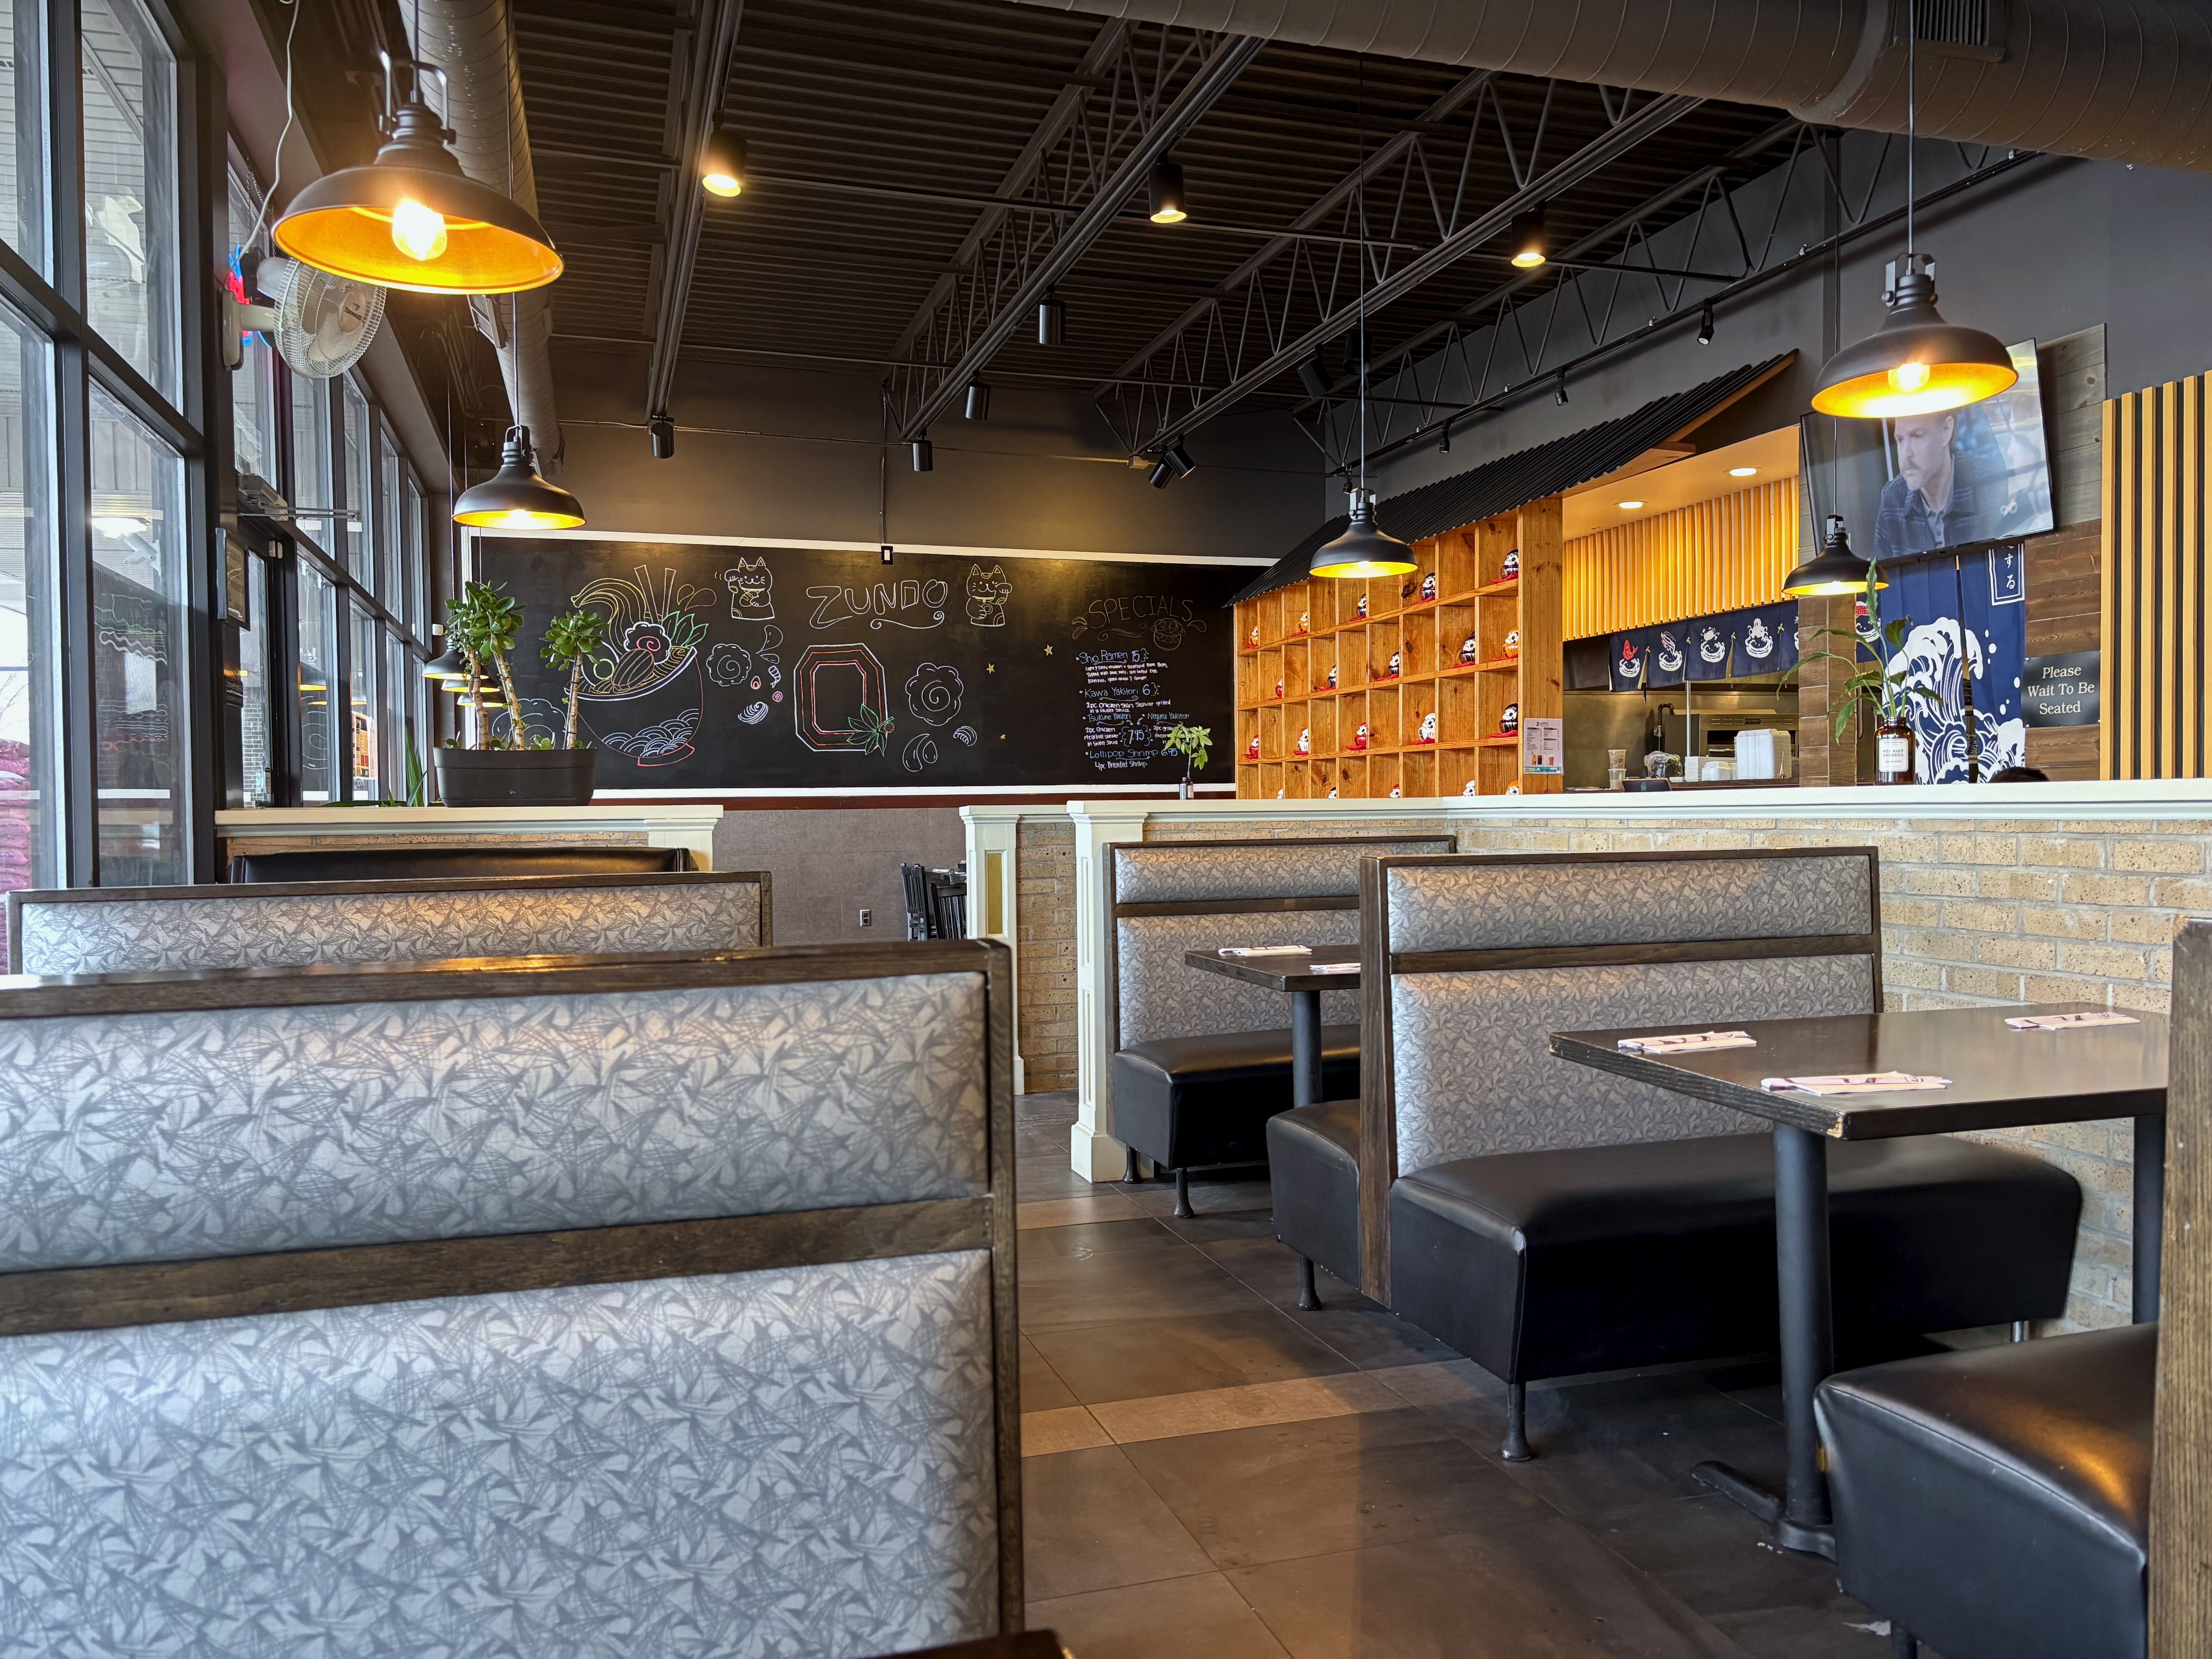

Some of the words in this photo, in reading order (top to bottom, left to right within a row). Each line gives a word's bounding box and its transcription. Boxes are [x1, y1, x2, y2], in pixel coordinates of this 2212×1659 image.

[2001, 546, 2016, 590] する
[806, 579, 948, 629] ZUNDO
[1089, 595, 1194, 629] SPECIALS
[1079, 652, 1099, 664] Shio
[1101, 650, 1128, 662] Ramen
[1131, 650, 1140, 663] 15
[2042, 666, 2082, 679] Please
[1085, 688, 1108, 698] Kawa
[1111, 687, 1138, 696] Yakitori
[1142, 684, 1151, 695] 6
[2028, 685, 2055, 697] Wait
[2058, 683, 2074, 695] To
[2078, 682, 2095, 694] Be
[2039, 701, 2081, 715] Seated
[1128, 730, 1144, 744] 7.95
[1089, 750, 1125, 759] Lollipop
[1127, 749, 1158, 758] Shrimp
[1161, 748, 1178, 756] 6.95
